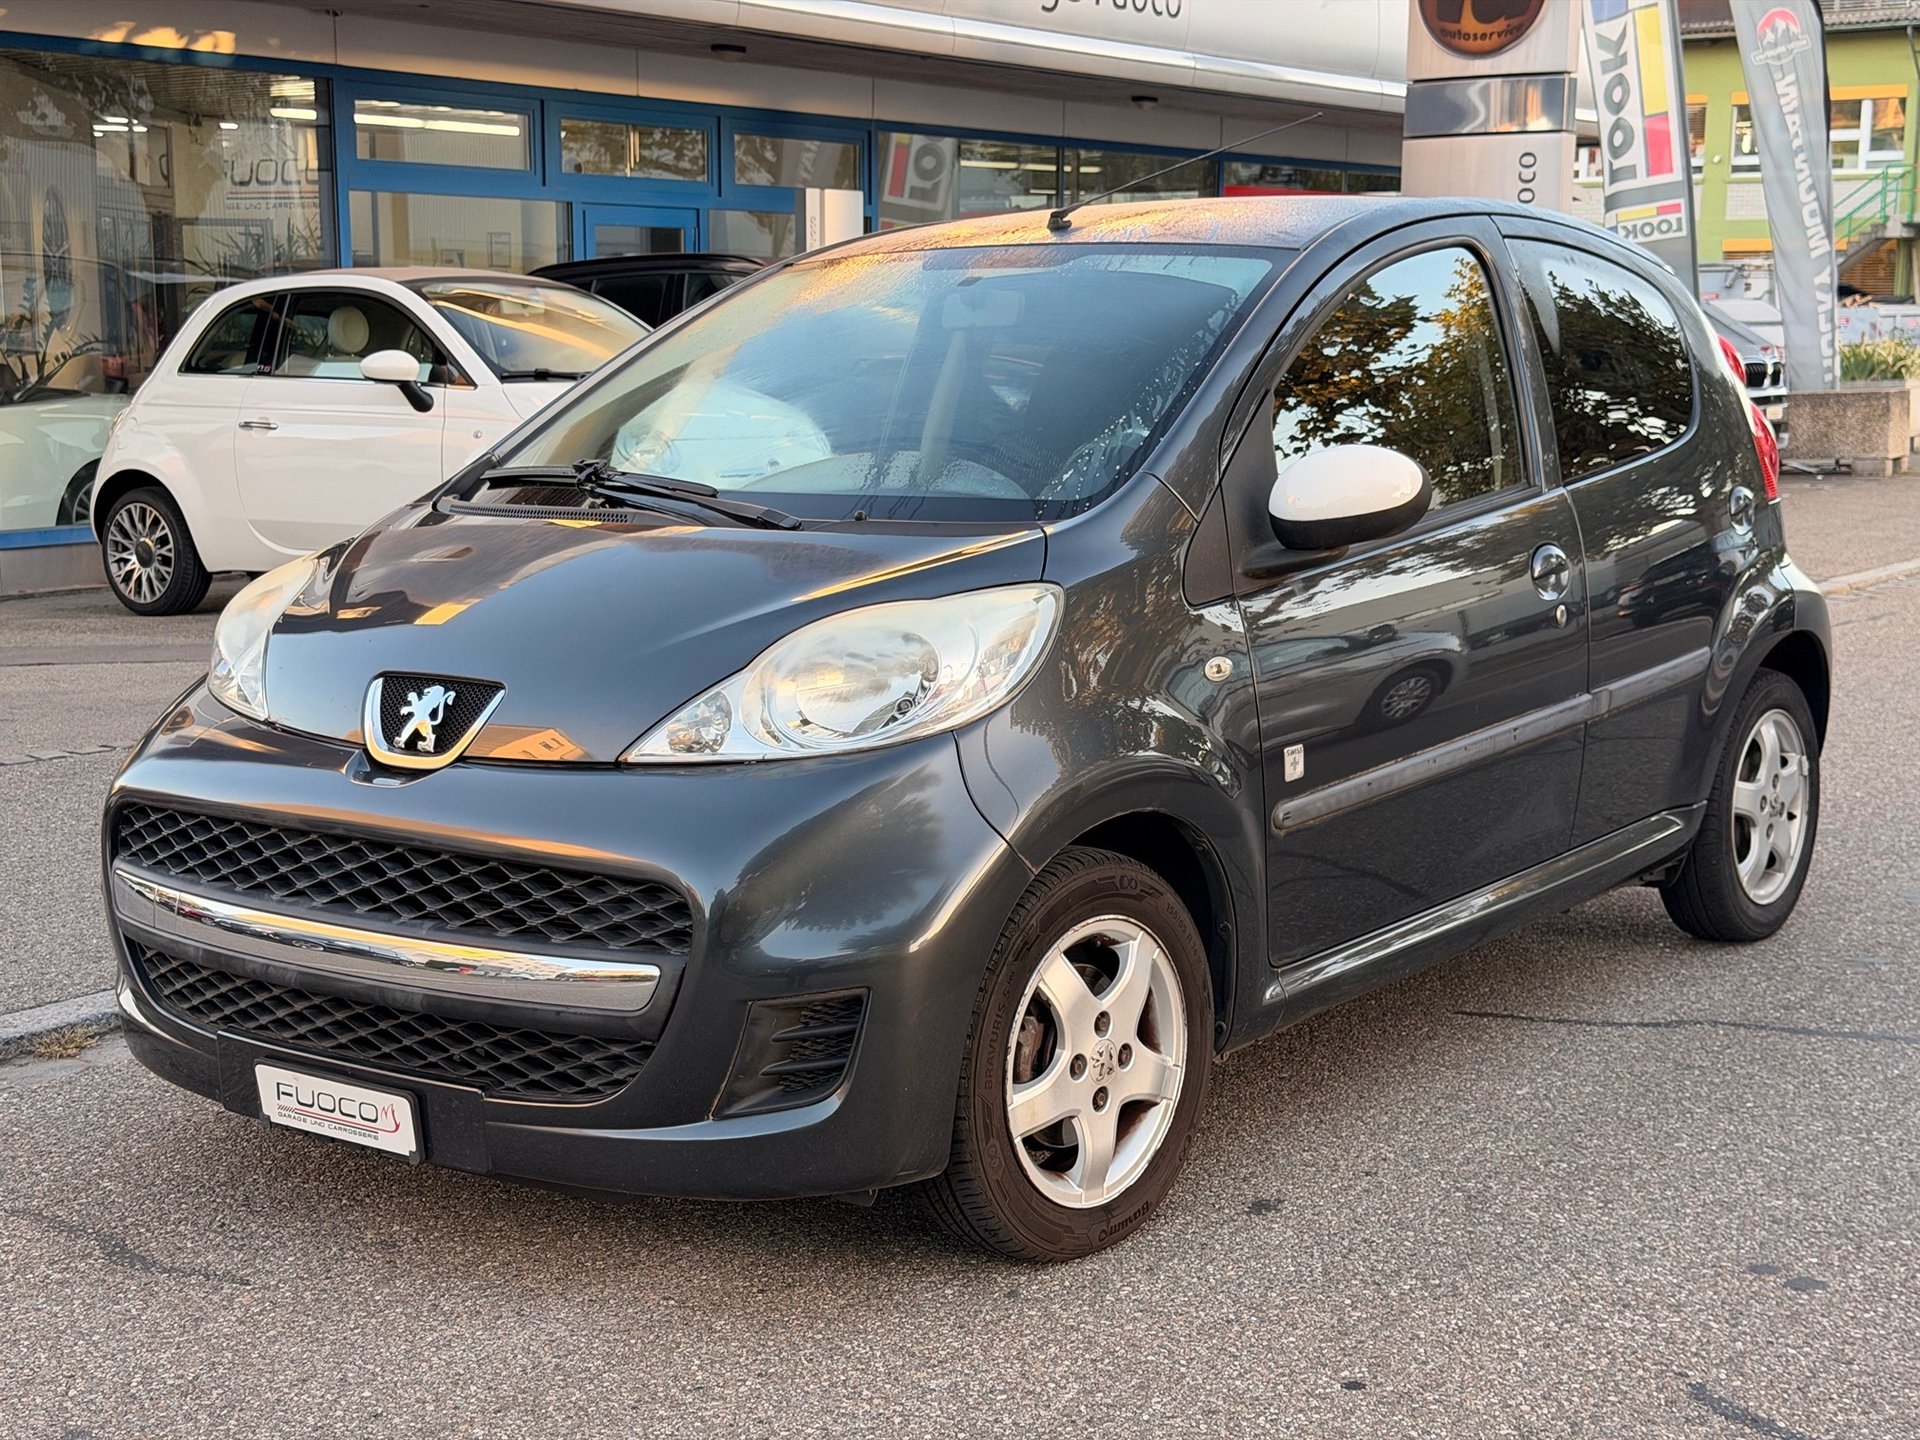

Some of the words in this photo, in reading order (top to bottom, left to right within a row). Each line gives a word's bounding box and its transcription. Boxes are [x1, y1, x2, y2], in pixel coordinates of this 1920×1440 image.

[276, 1081, 379, 1123] FUOCO
[277, 1111, 308, 1124] GARAGE
[310, 1119, 326, 1128] UND
[327, 1123, 380, 1141] CARROSSERIE
